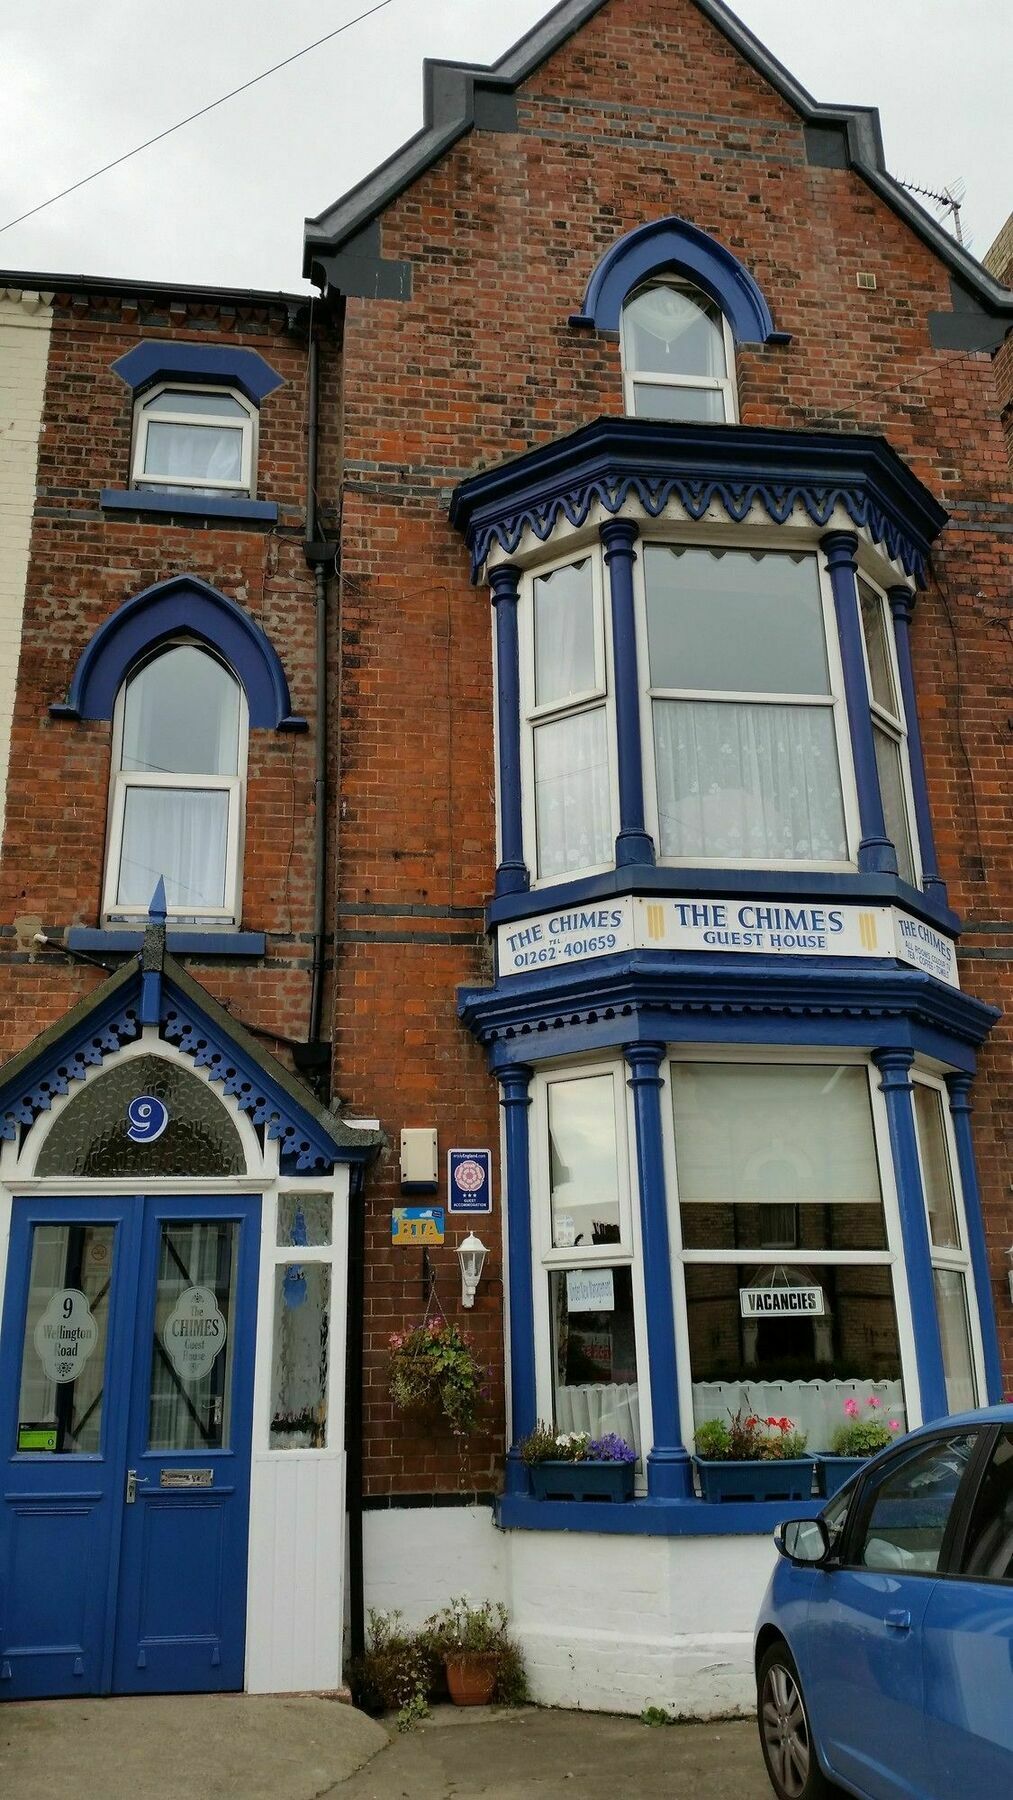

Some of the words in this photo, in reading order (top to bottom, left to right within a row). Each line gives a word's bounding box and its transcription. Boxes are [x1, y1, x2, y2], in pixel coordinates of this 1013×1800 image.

[674, 904, 726, 927] THE
[738, 906, 843, 932] CHIMES
[506, 924, 543, 952] THE
[548, 910, 622, 934] CHIMES
[703, 931, 763, 946] GUEST
[770, 934, 825, 948] HOUSE
[898, 920, 917, 937] THE
[917, 925, 951, 961] CHIMES
[127, 1095, 169, 1143] 9
[63, 1297, 74, 1319] 9
[748, 1293, 817, 1311] VACANCIES
[43, 1325, 93, 1342] Wellington
[172, 1319, 220, 1337] CHIMES
[55, 1342, 78, 1357] Road
